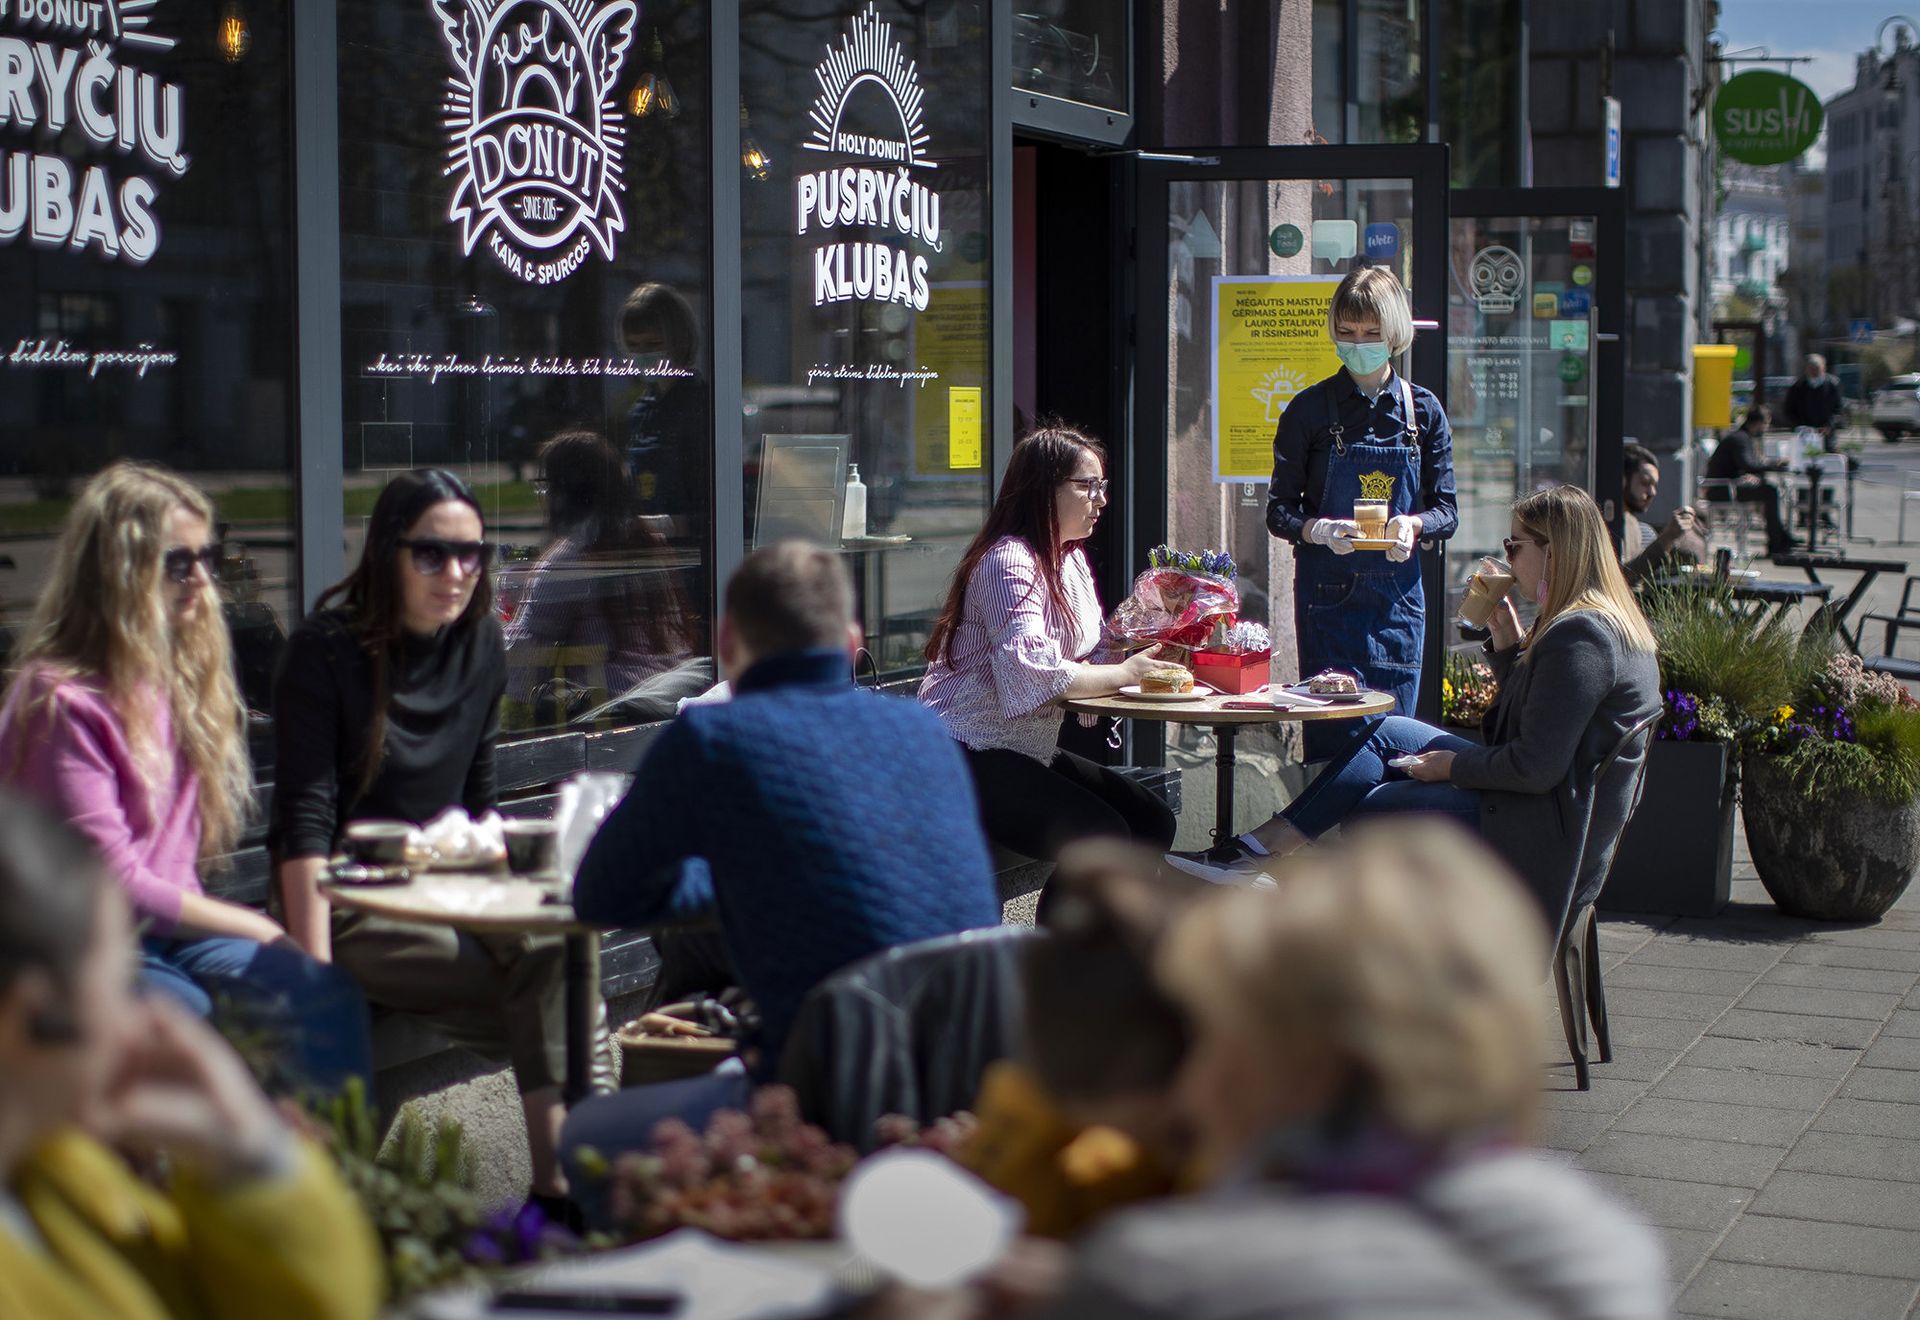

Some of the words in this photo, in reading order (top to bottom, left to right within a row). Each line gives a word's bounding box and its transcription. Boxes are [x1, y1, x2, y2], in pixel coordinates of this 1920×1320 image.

[20, 0, 102, 31] DONUT
[1725, 88, 1809, 145] SUSHI
[473, 123, 599, 196] DONUT
[838, 132, 866, 155] HOLY
[869, 137, 906, 161] DONUT
[0, 152, 157, 261] UBAS
[523, 195, 542, 220] SINCE
[798, 166, 942, 253] PUSRYČIŲ
[490, 229, 521, 277] KAVA
[525, 261, 536, 281] &
[538, 235, 590, 284] SPURGOS
[815, 242, 929, 311] KLUBAS
[1279, 308, 1315, 317] GALIMA
[1286, 298, 1322, 306] MAISTU
[1245, 319, 1277, 328] LAUKO
[1251, 330, 1260, 338] IR
[431, 354, 478, 384] pilnos
